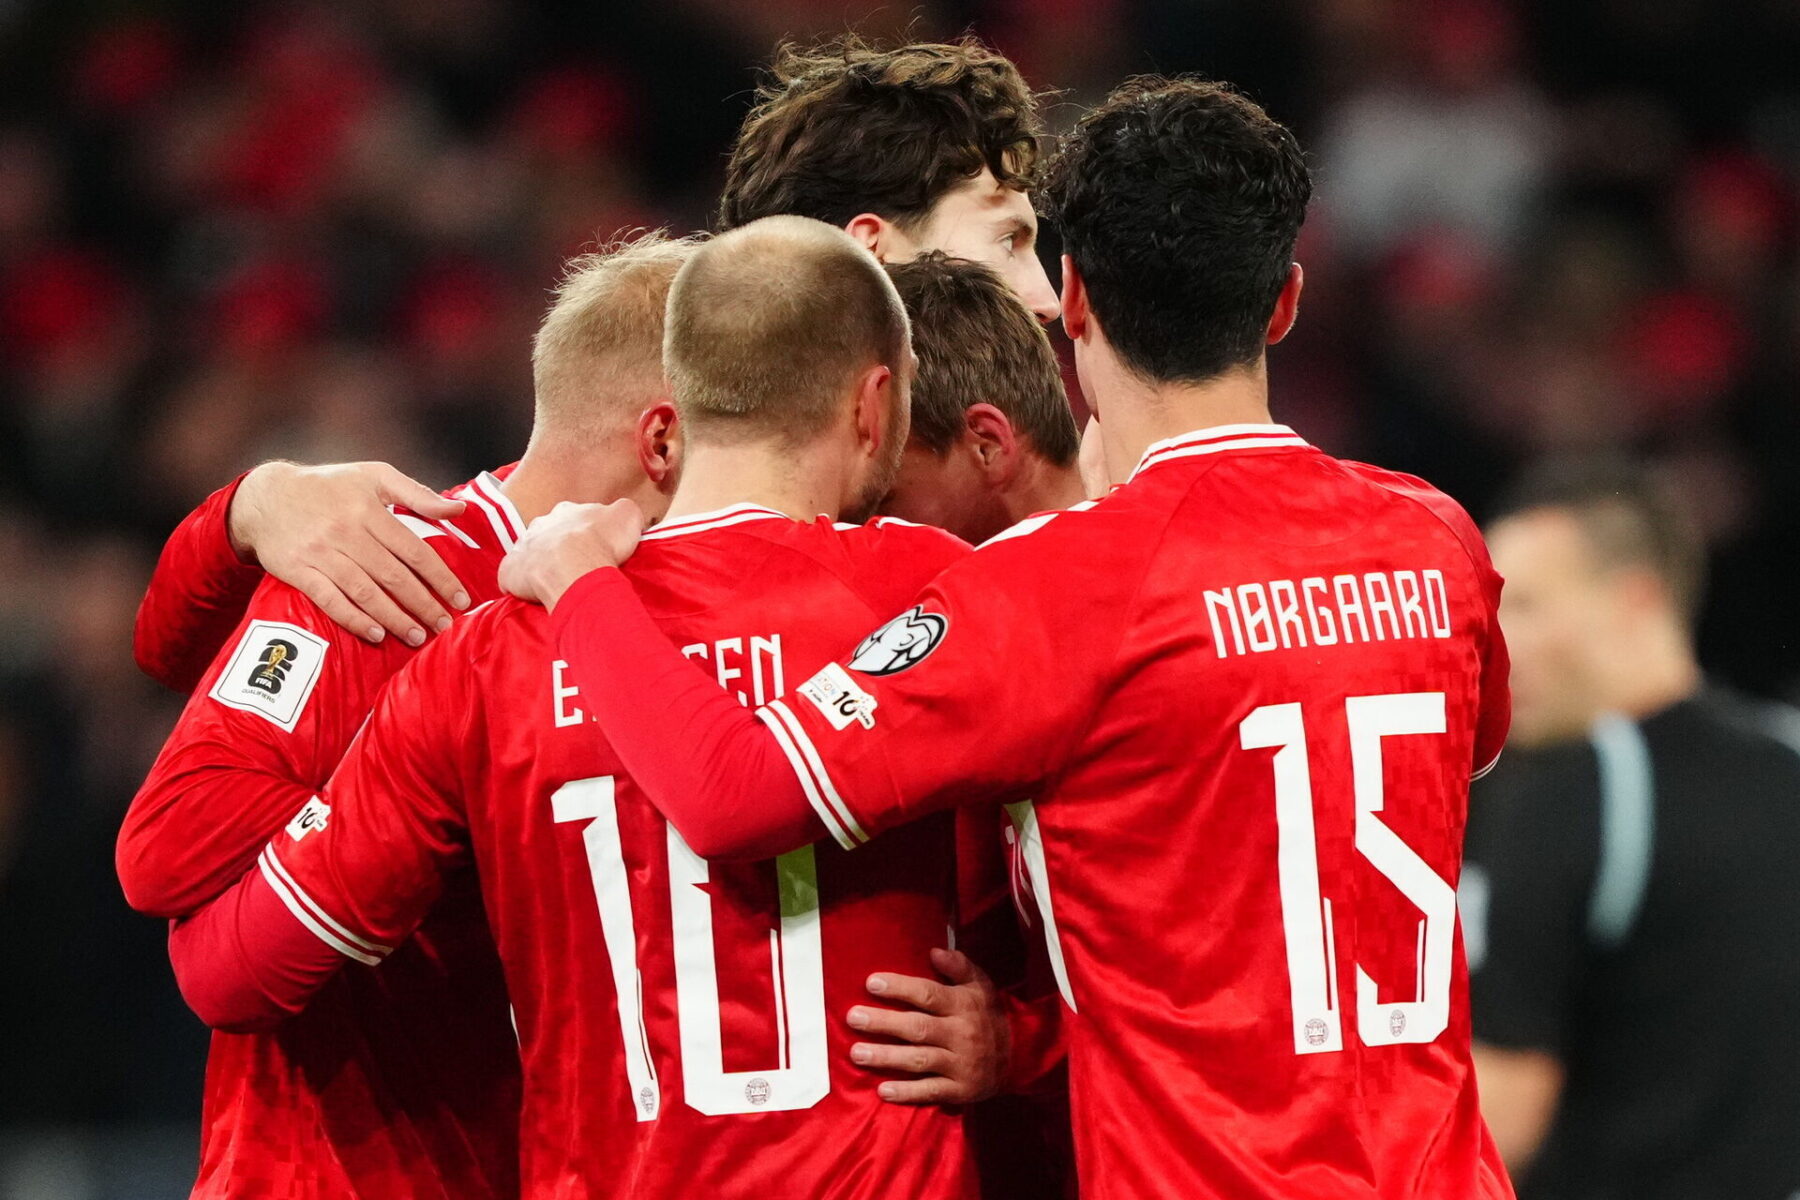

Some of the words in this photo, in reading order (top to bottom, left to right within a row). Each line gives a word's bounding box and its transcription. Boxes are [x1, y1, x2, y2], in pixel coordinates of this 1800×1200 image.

[1203, 569, 1451, 658] NØRGAARD
[550, 775, 831, 1122] 10
[1239, 692, 1456, 1055] 15
